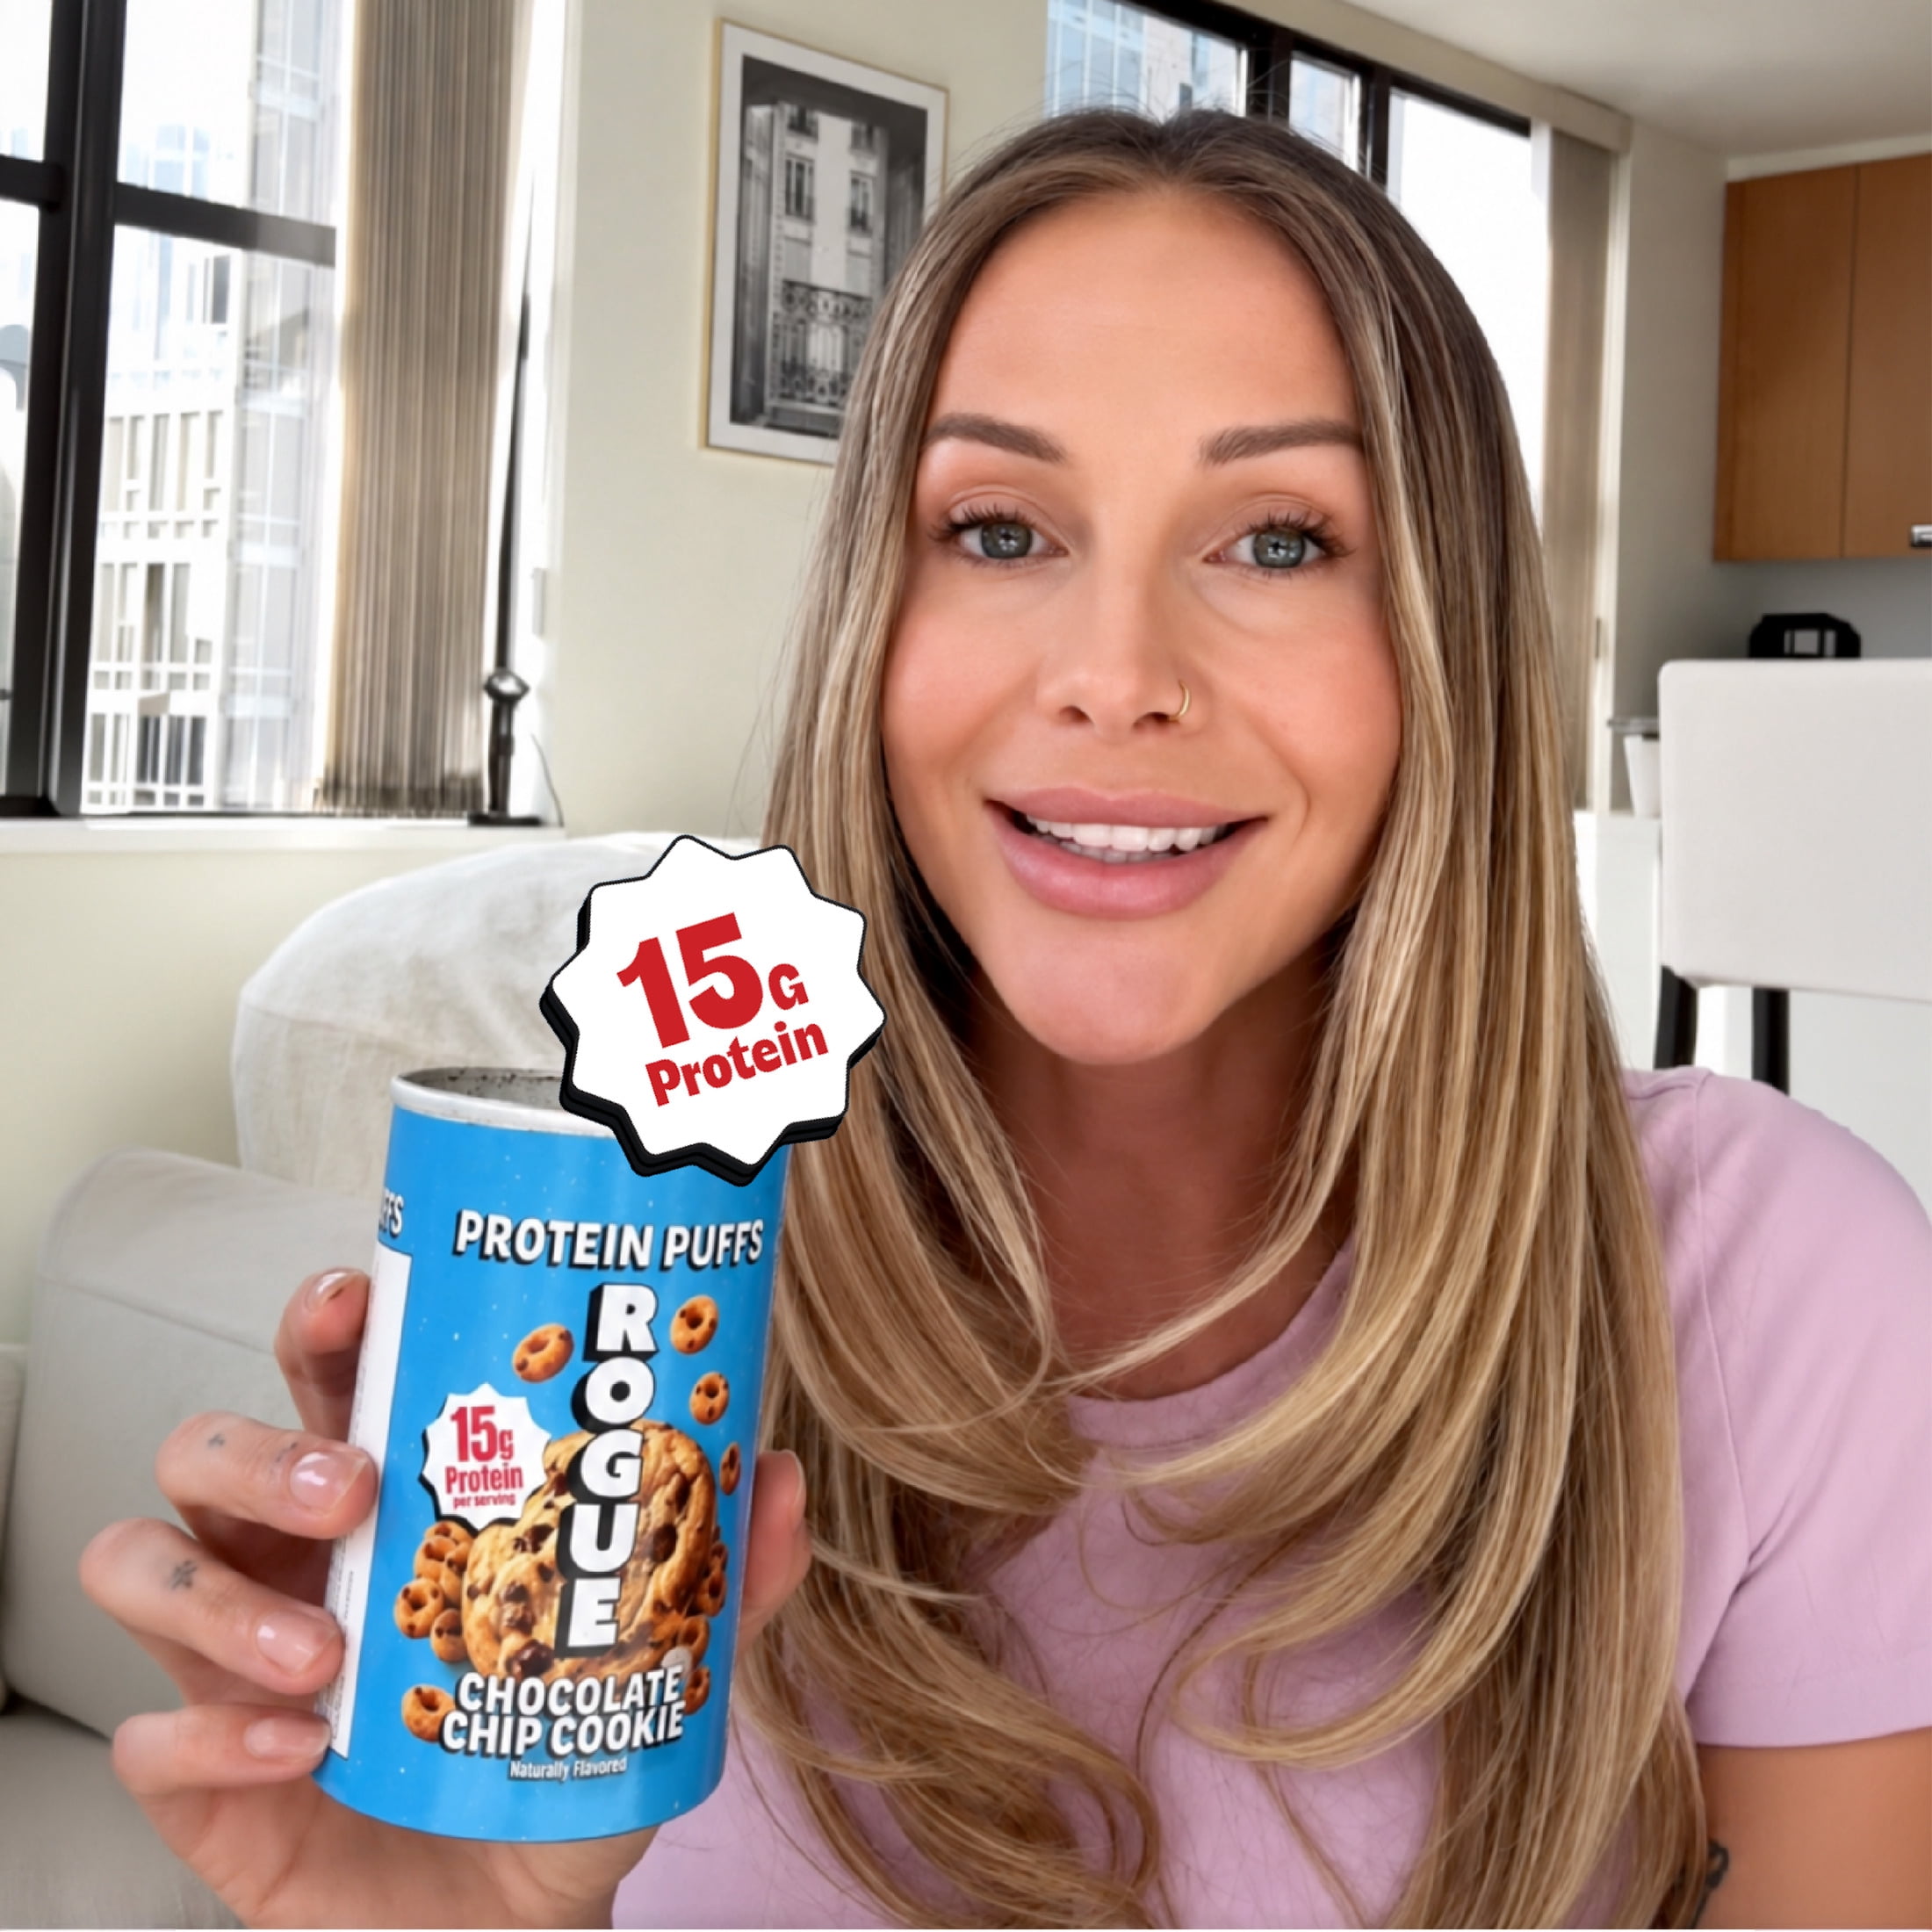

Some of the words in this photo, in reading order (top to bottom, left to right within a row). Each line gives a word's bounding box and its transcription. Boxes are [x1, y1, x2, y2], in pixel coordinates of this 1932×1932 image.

[455, 1208, 654, 1269] PROTEIN
[663, 1219, 764, 1269] PUFFS
[450, 1405, 515, 1461] 15g
[444, 1462, 524, 1494] Protein
[562, 1283, 659, 1650] ROGUE
[452, 1496, 472, 1510] per
[474, 1493, 516, 1507] serving
[458, 1664, 683, 1717] CHOCOLATE
[442, 1711, 543, 1756] CHIP
[550, 1700, 687, 1756] COOKIE
[509, 1760, 569, 1781] Naturally
[573, 1755, 628, 1777] Flavored
